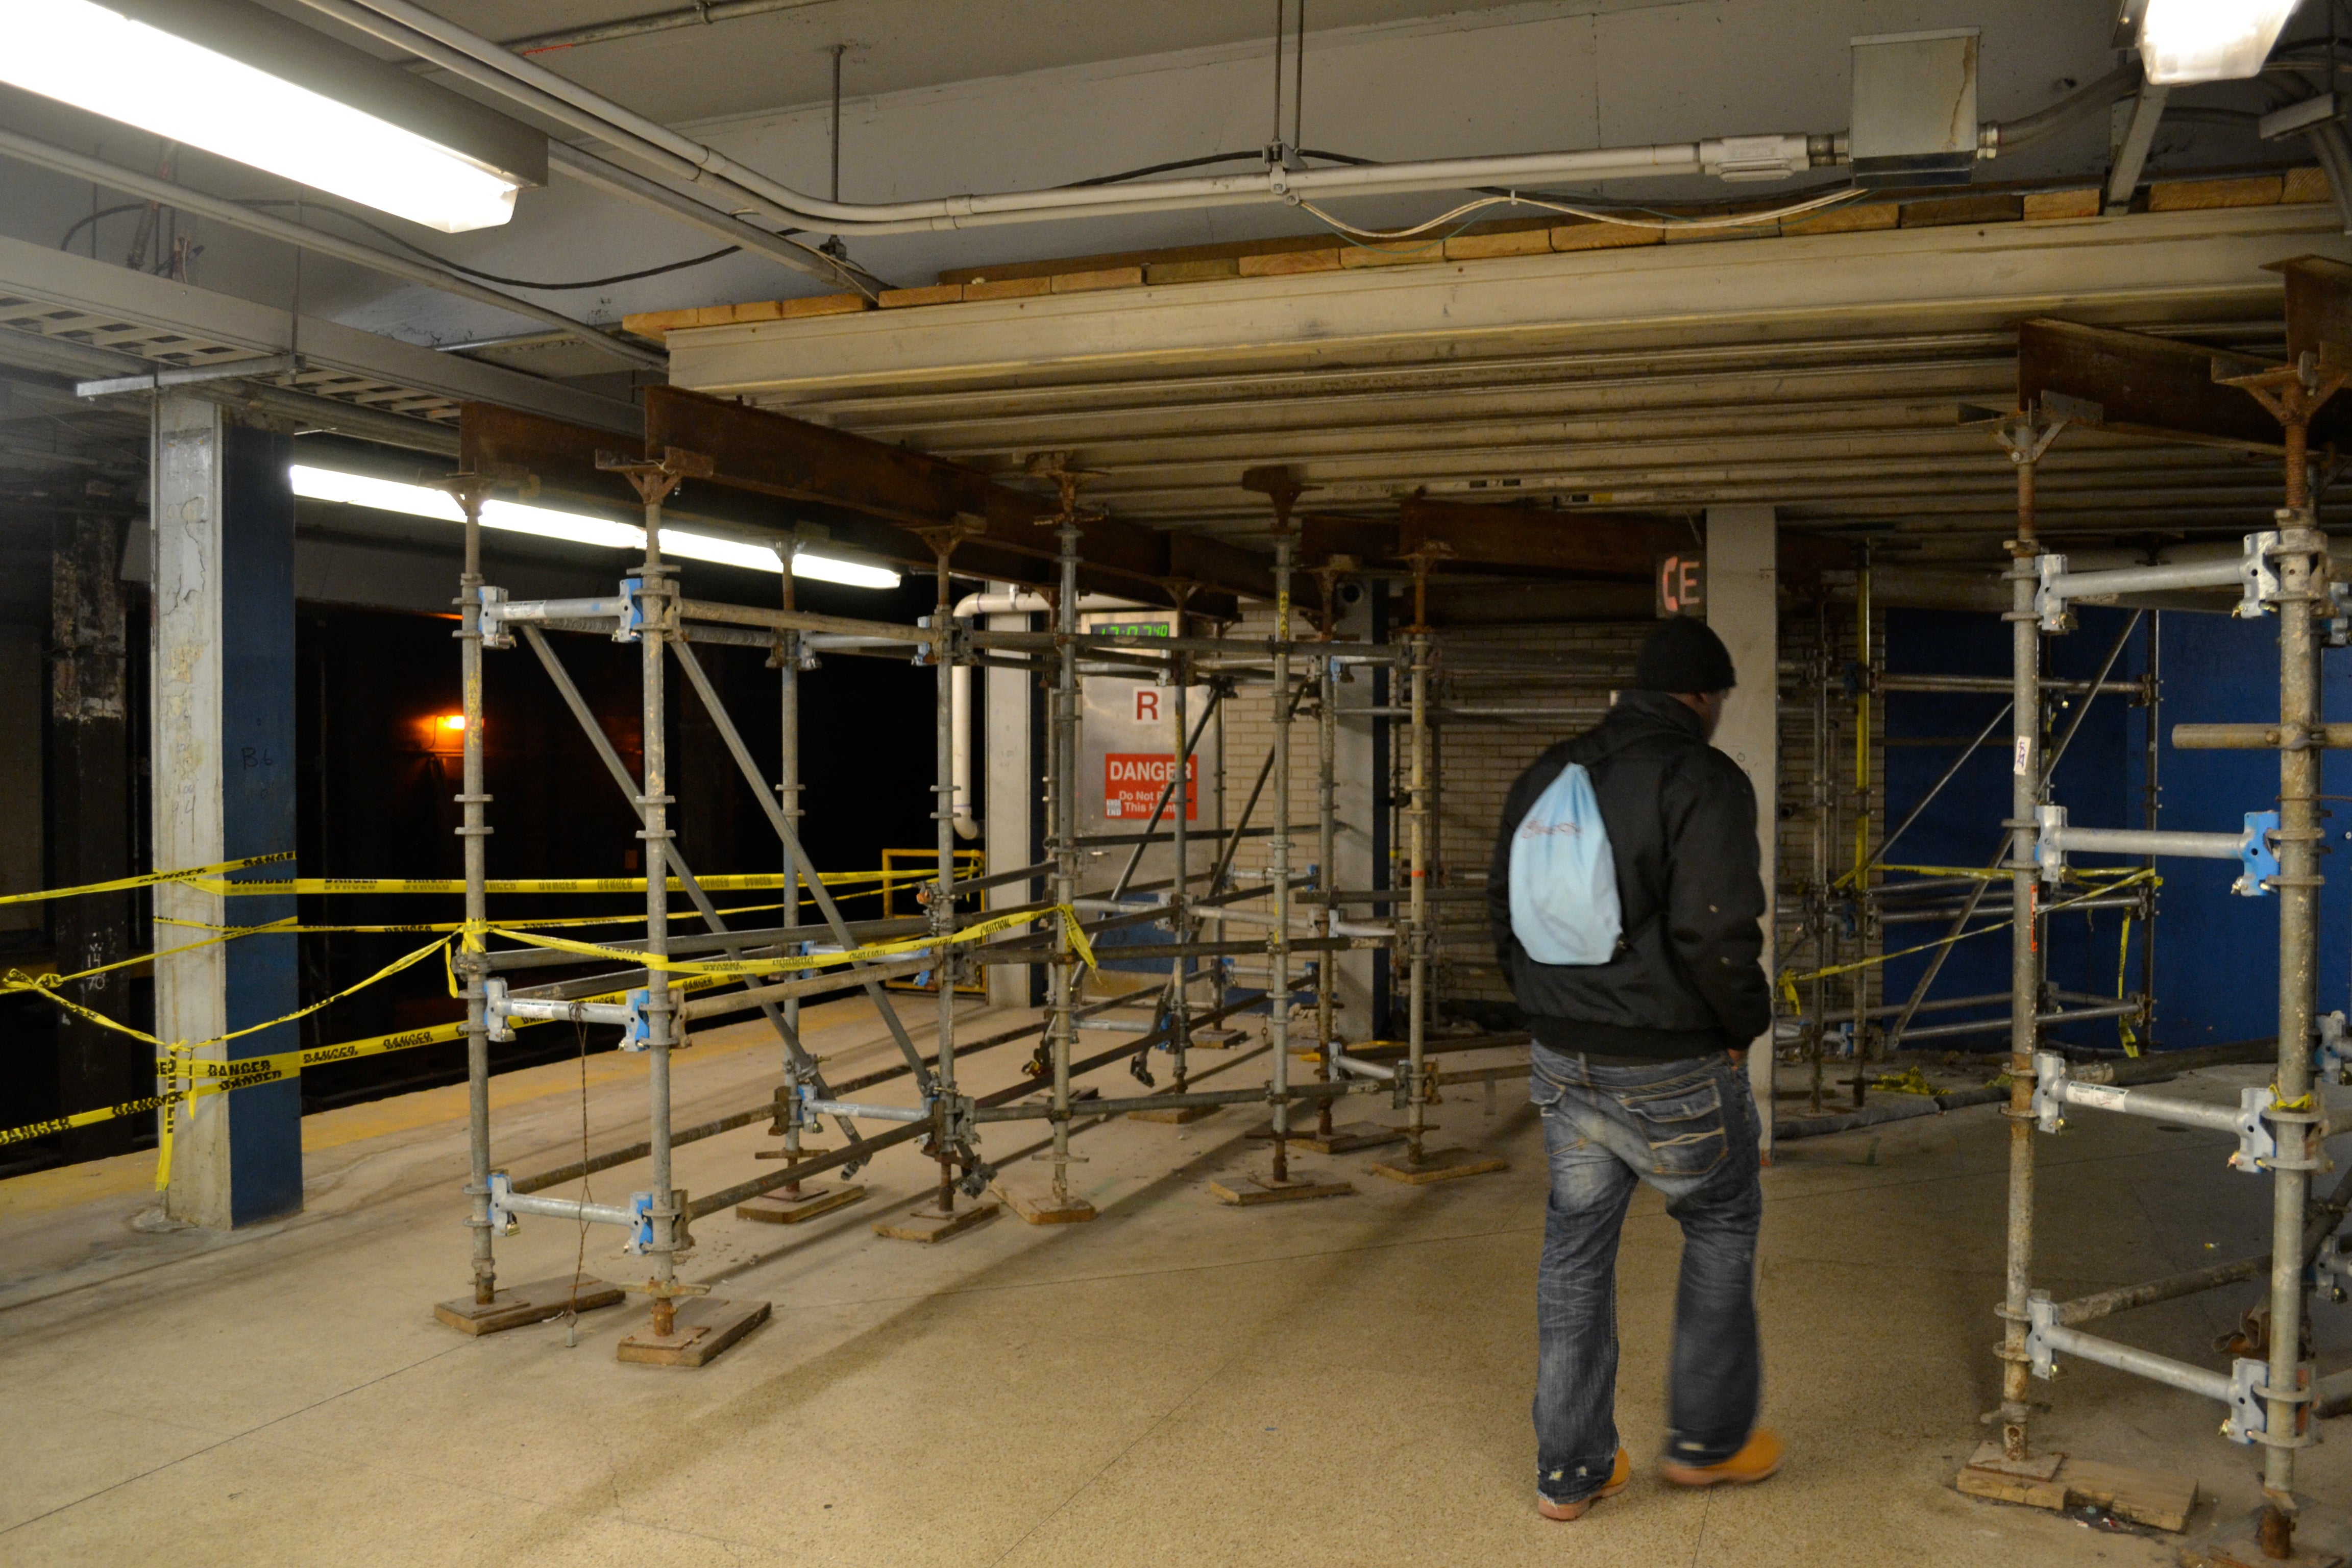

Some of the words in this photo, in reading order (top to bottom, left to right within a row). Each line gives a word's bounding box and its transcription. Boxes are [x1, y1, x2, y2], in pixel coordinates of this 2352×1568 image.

[1137, 691, 1159, 720] R
[1119, 791, 1133, 800] Do
[1137, 791, 1154, 800] Not
[1125, 802, 1146, 812] This
[384, 1032, 433, 1049] DANGER
[303, 1046, 358, 1064] DANGER
[208, 1060, 271, 1076] DANGER
